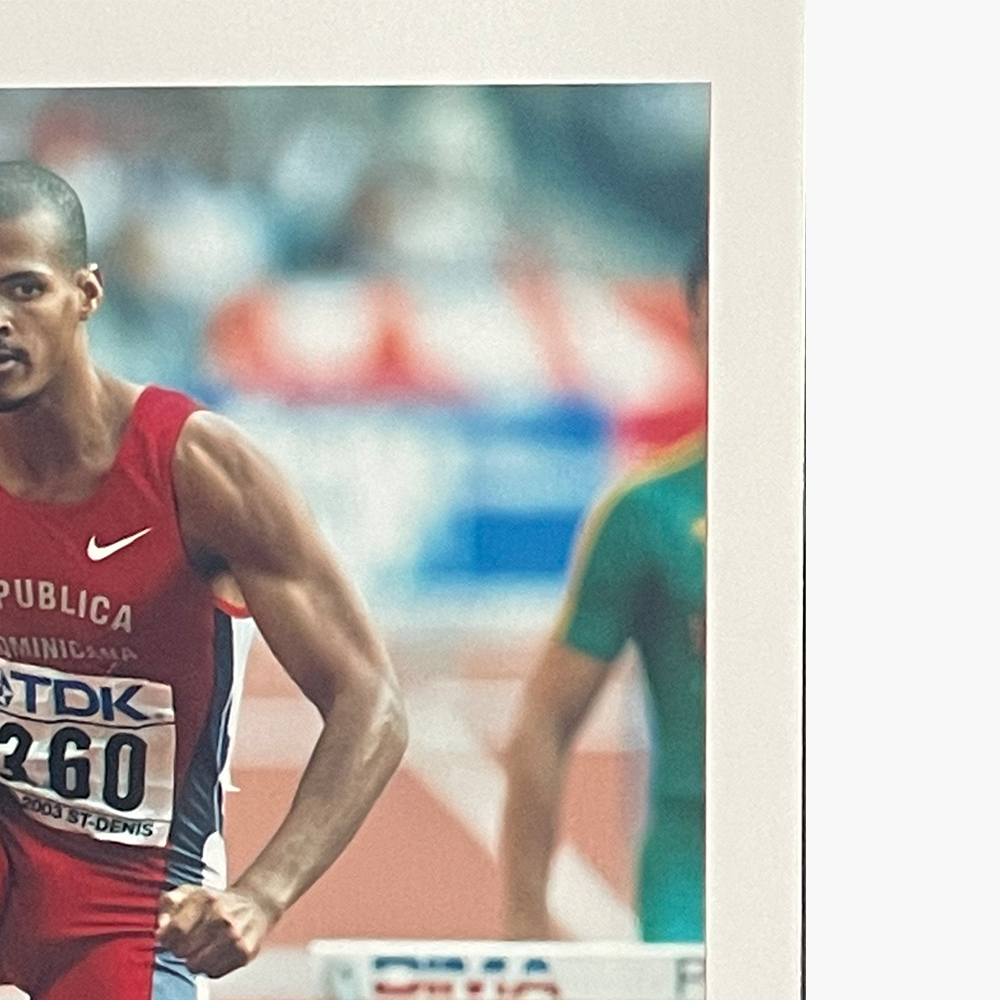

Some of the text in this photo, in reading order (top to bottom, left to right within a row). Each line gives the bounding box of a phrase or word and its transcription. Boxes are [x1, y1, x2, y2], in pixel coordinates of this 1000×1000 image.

[10, 670, 149, 721] TDK
[22, 797, 153, 837] 2003 ST-DENIS
